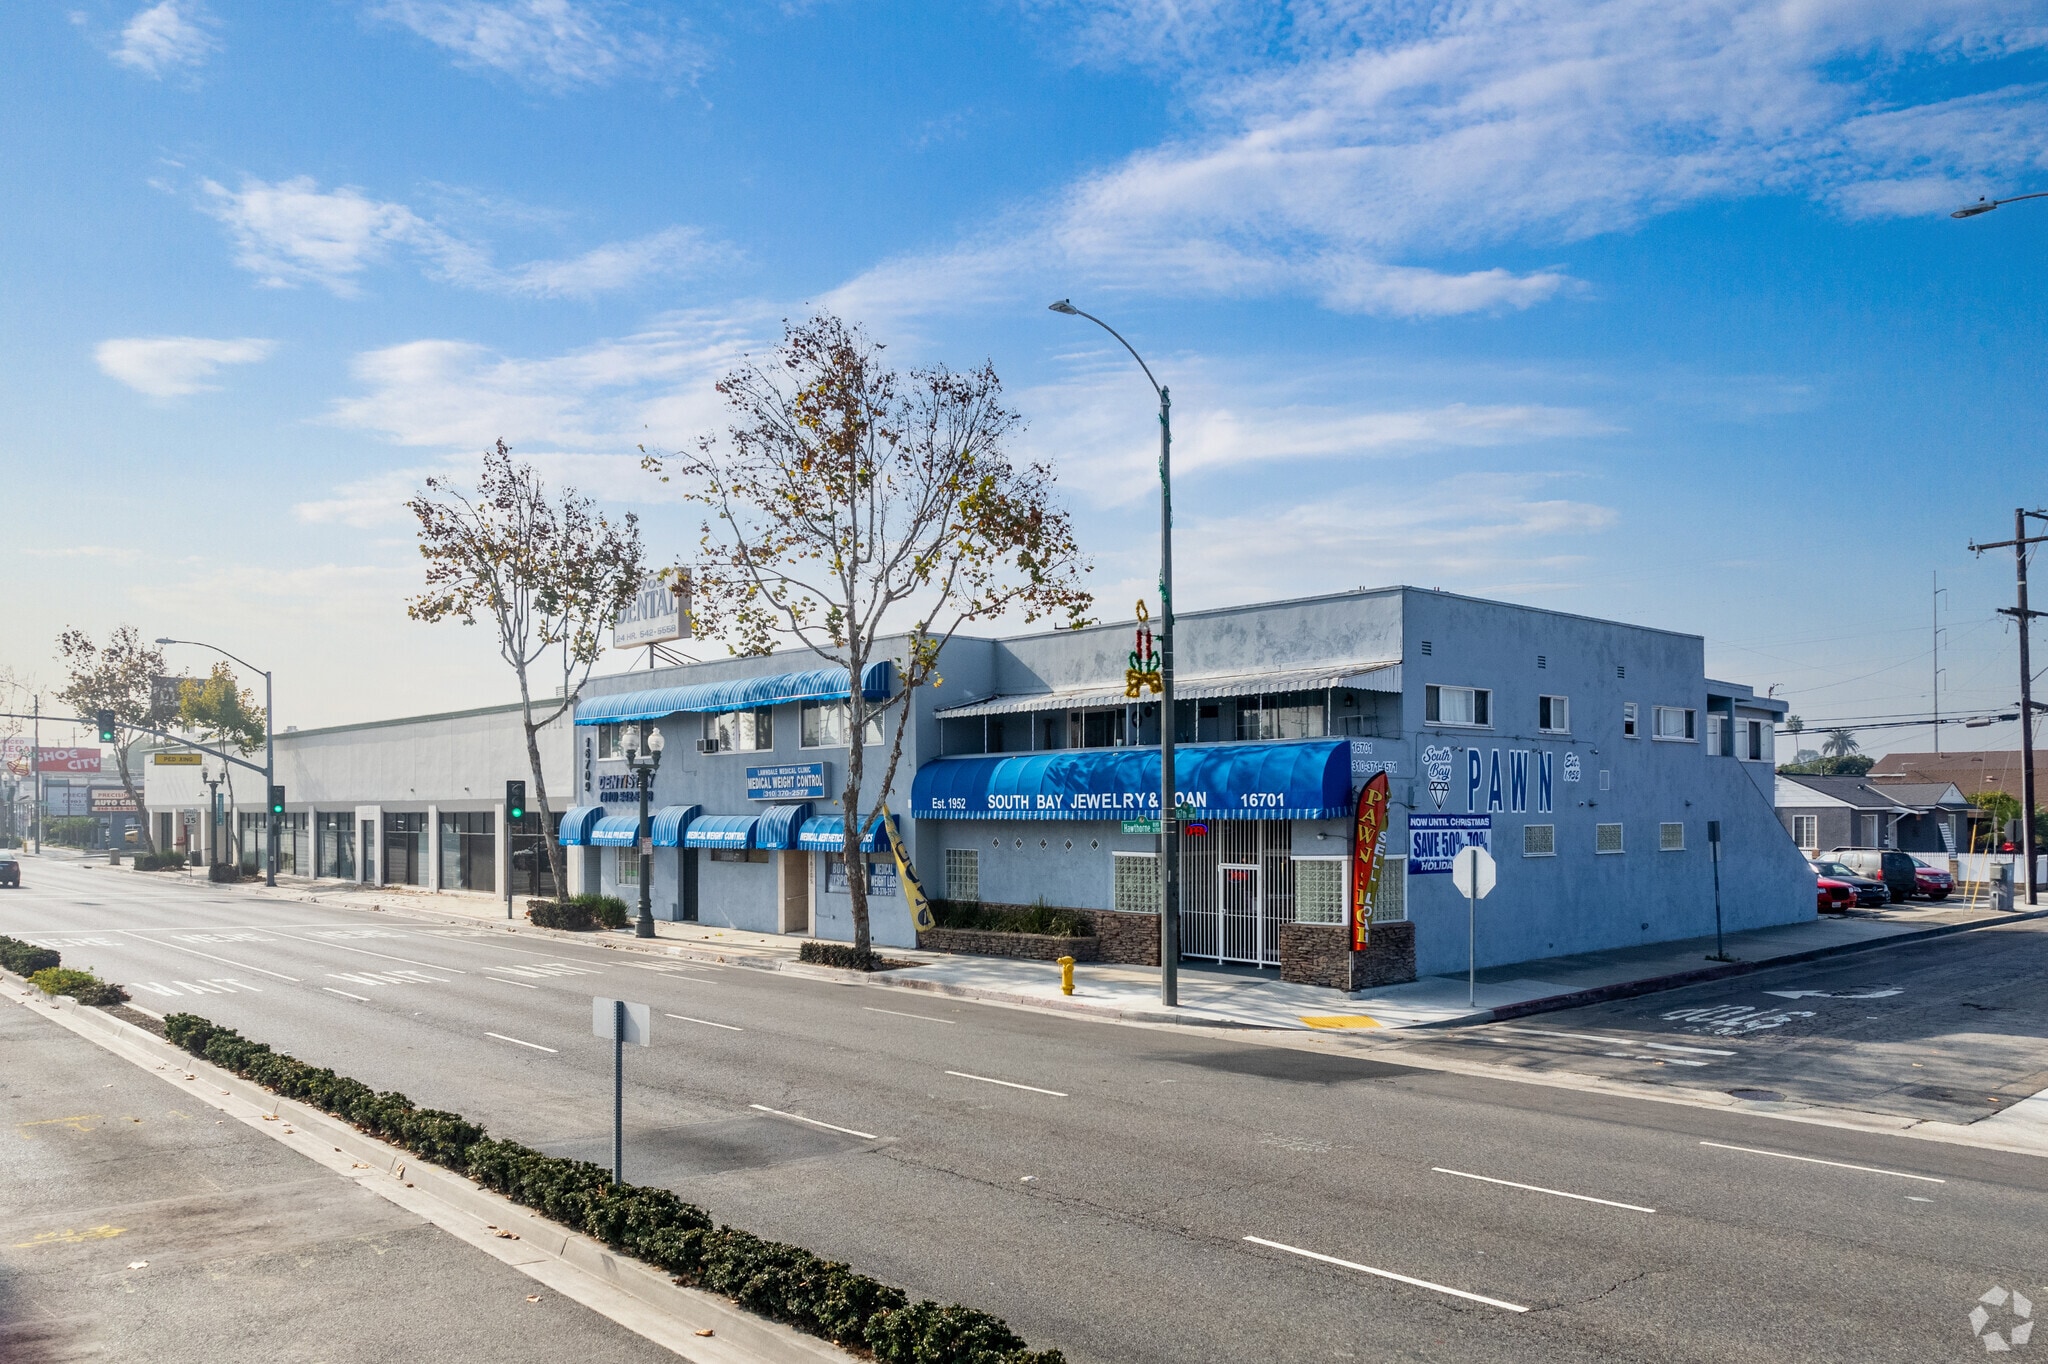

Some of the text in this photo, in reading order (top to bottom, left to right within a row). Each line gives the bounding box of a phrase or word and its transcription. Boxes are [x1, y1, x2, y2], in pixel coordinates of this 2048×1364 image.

[616, 588, 678, 625] DENTAL
[1351, 741, 1373, 754] 16701
[1421, 743, 1452, 764] South
[38, 748, 78, 763] SHOE
[1564, 752, 1580, 768] Est.
[67, 758, 99, 770] CITY
[779, 767, 797, 775] MEDICAL
[798, 766, 812, 774] CLINIC
[1351, 759, 1398, 774] 310-371-4571
[1429, 762, 1451, 780] Bay
[747, 774, 823, 790] MEDICAL WEIGHT CONTROL
[1467, 747, 1552, 813] PAWN
[1563, 768, 1581, 782] 1952
[777, 789, 809, 797] 370-2577
[987, 791, 1207, 809] SOUTH BAY JEWELRY & OAN
[1240, 793, 1285, 808] 16701
[932, 797, 966, 809] Est. 1952
[1123, 823, 1151, 833] Hawthorne
[1410, 818, 1490, 827] NOW UNTIL CHRISTMAS
[1185, 825, 1207, 836] OPEN
[1413, 831, 1440, 858] SAVE
[1370, 831, 1387, 882] SELL
[875, 863, 894, 876] MEDICAL
[1421, 860, 1453, 871] HOLIDA
[870, 875, 897, 888] WEIGHT LOS
[323, 970, 451, 986] WAIT
[130, 978, 263, 997] WAIT
